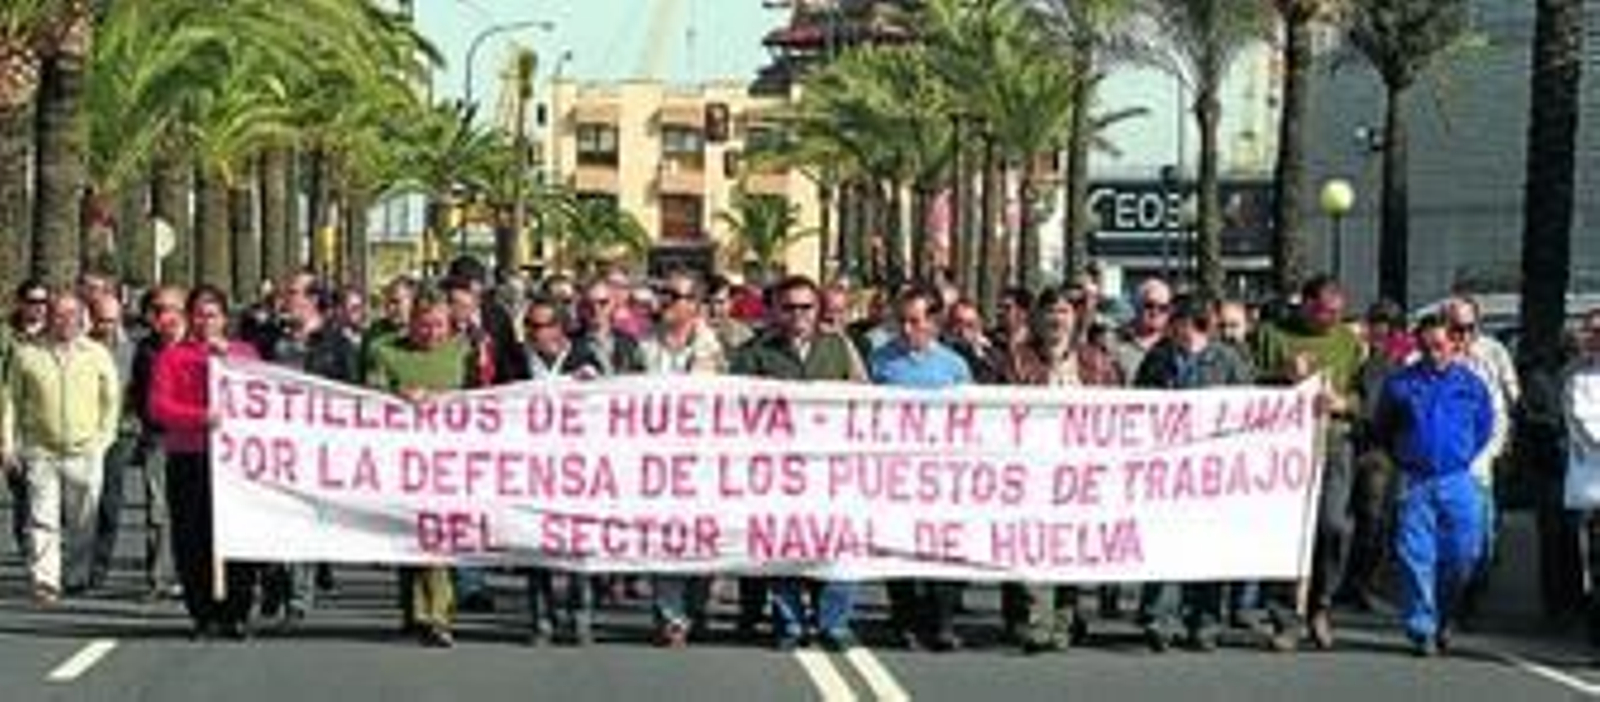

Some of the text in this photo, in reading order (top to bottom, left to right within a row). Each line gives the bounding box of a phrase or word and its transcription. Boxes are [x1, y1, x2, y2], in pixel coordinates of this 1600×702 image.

[219, 375, 501, 433] ASTILLEROS
[527, 393, 586, 434] DE
[608, 394, 795, 437] HUELVA
[1009, 402, 1031, 445] Y
[1062, 402, 1193, 447] NUEVA
[318, 443, 381, 490] LA
[401, 450, 619, 499] DEFENSA
[641, 454, 698, 499] DE
[718, 453, 807, 497] LOS
[828, 454, 1027, 504] PUESTOS
[1053, 463, 1108, 505] DE
[1122, 447, 1307, 501] TRABAJO
[416, 510, 1144, 566] DEL SECTOR NAVAL DE HUELVA
